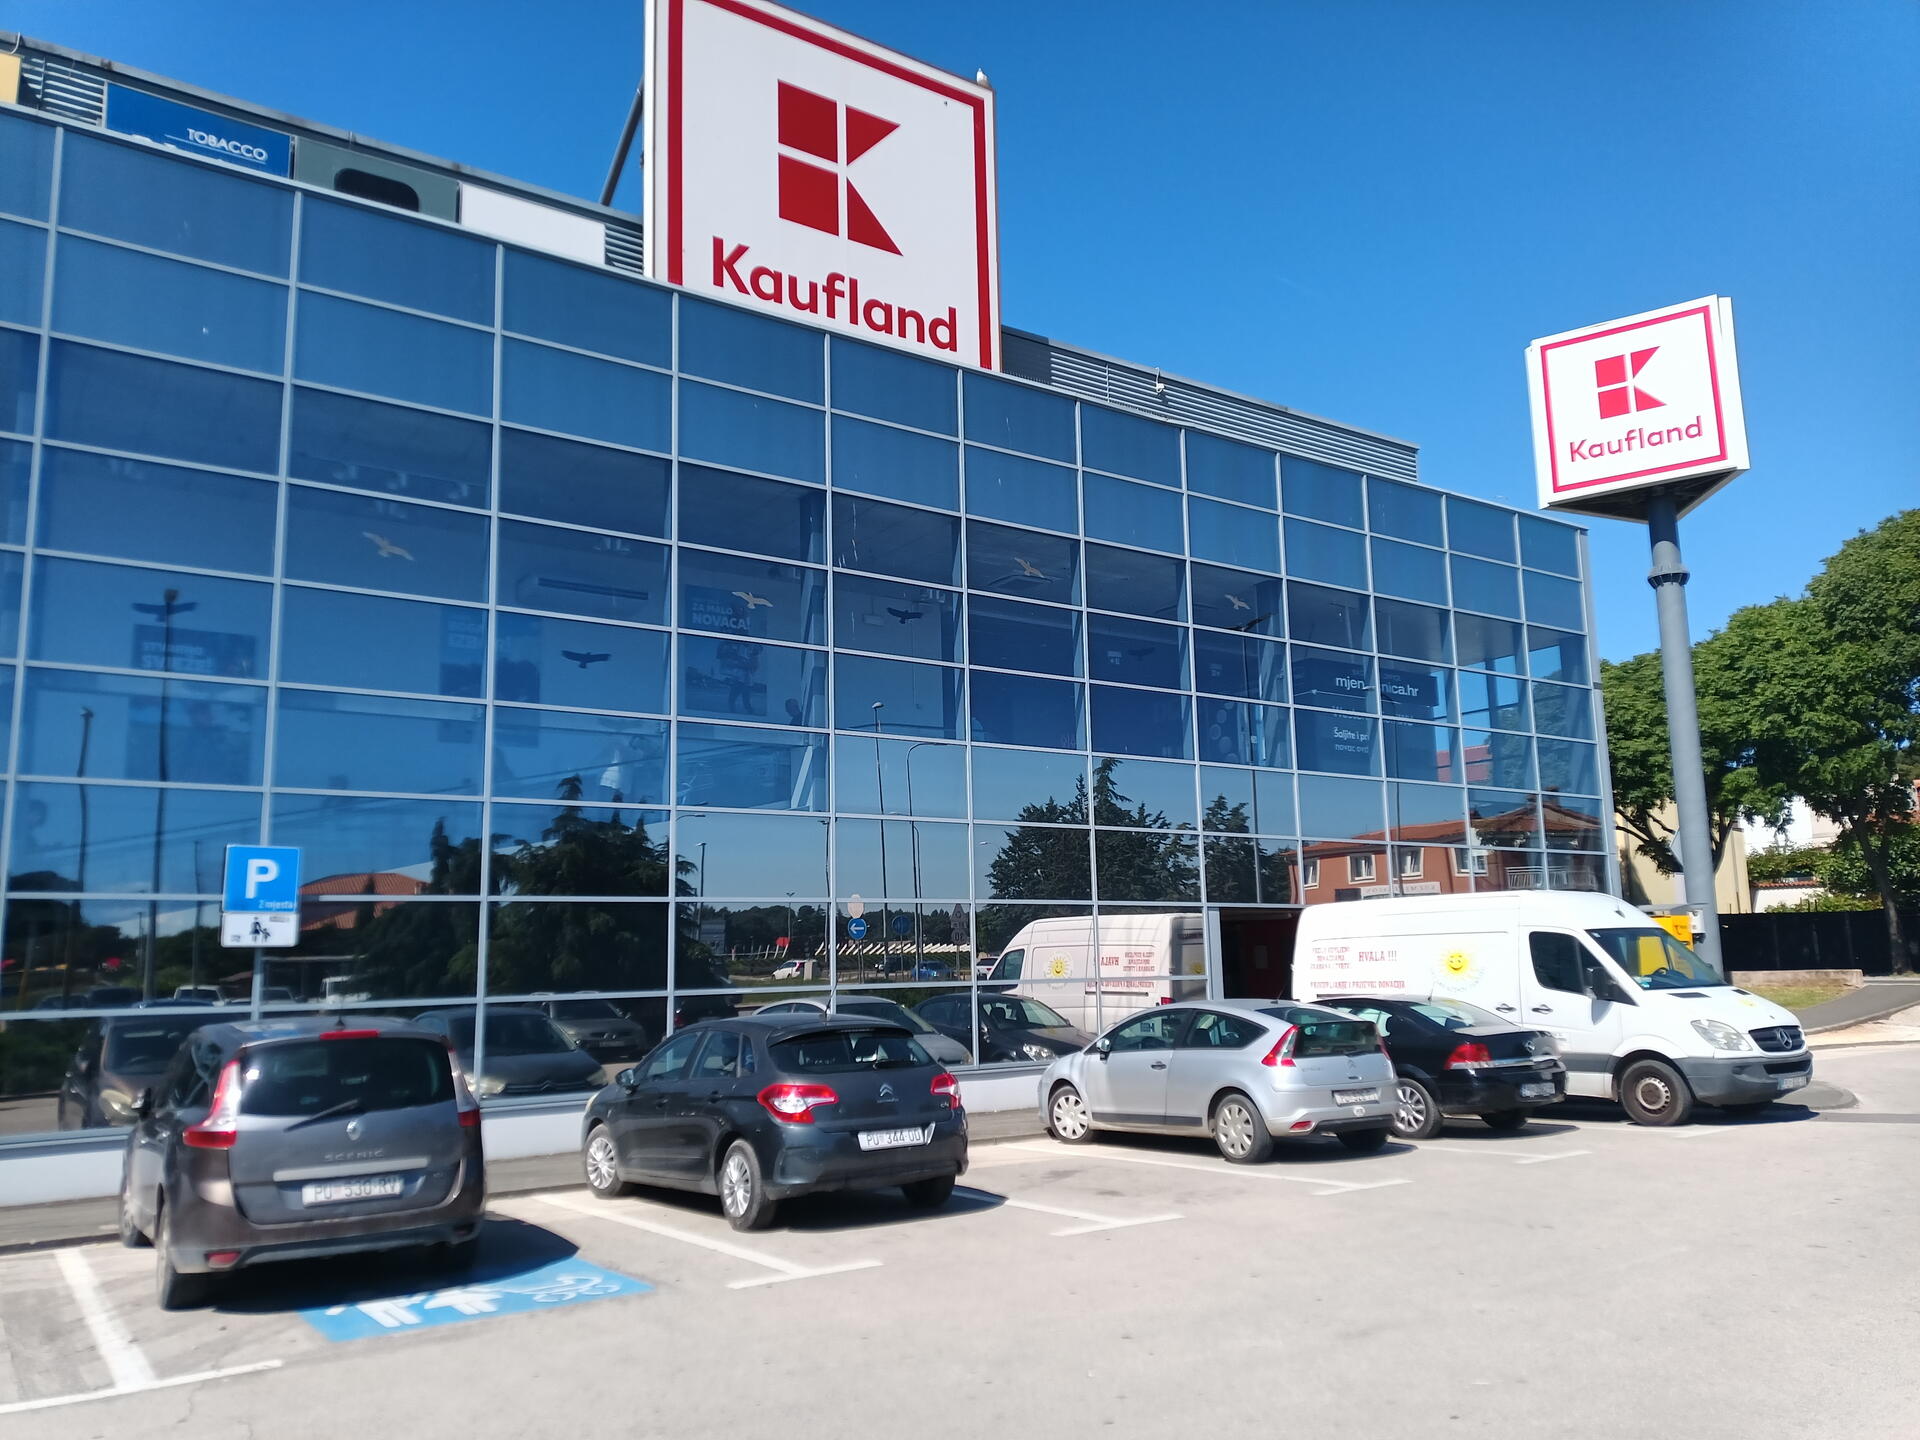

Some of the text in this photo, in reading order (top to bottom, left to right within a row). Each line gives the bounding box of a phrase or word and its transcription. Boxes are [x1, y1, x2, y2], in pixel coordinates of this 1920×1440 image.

[187, 127, 269, 161] TOBACCO
[712, 235, 958, 353] Kaufland
[1569, 415, 1704, 463] Kaufland
[1335, 675, 1419, 697] mjennica.hr
[245, 858, 279, 899] P
[1358, 951, 1386, 962] HVALA
[866, 1133, 880, 1146] PU
[314, 1184, 332, 1200] PU
